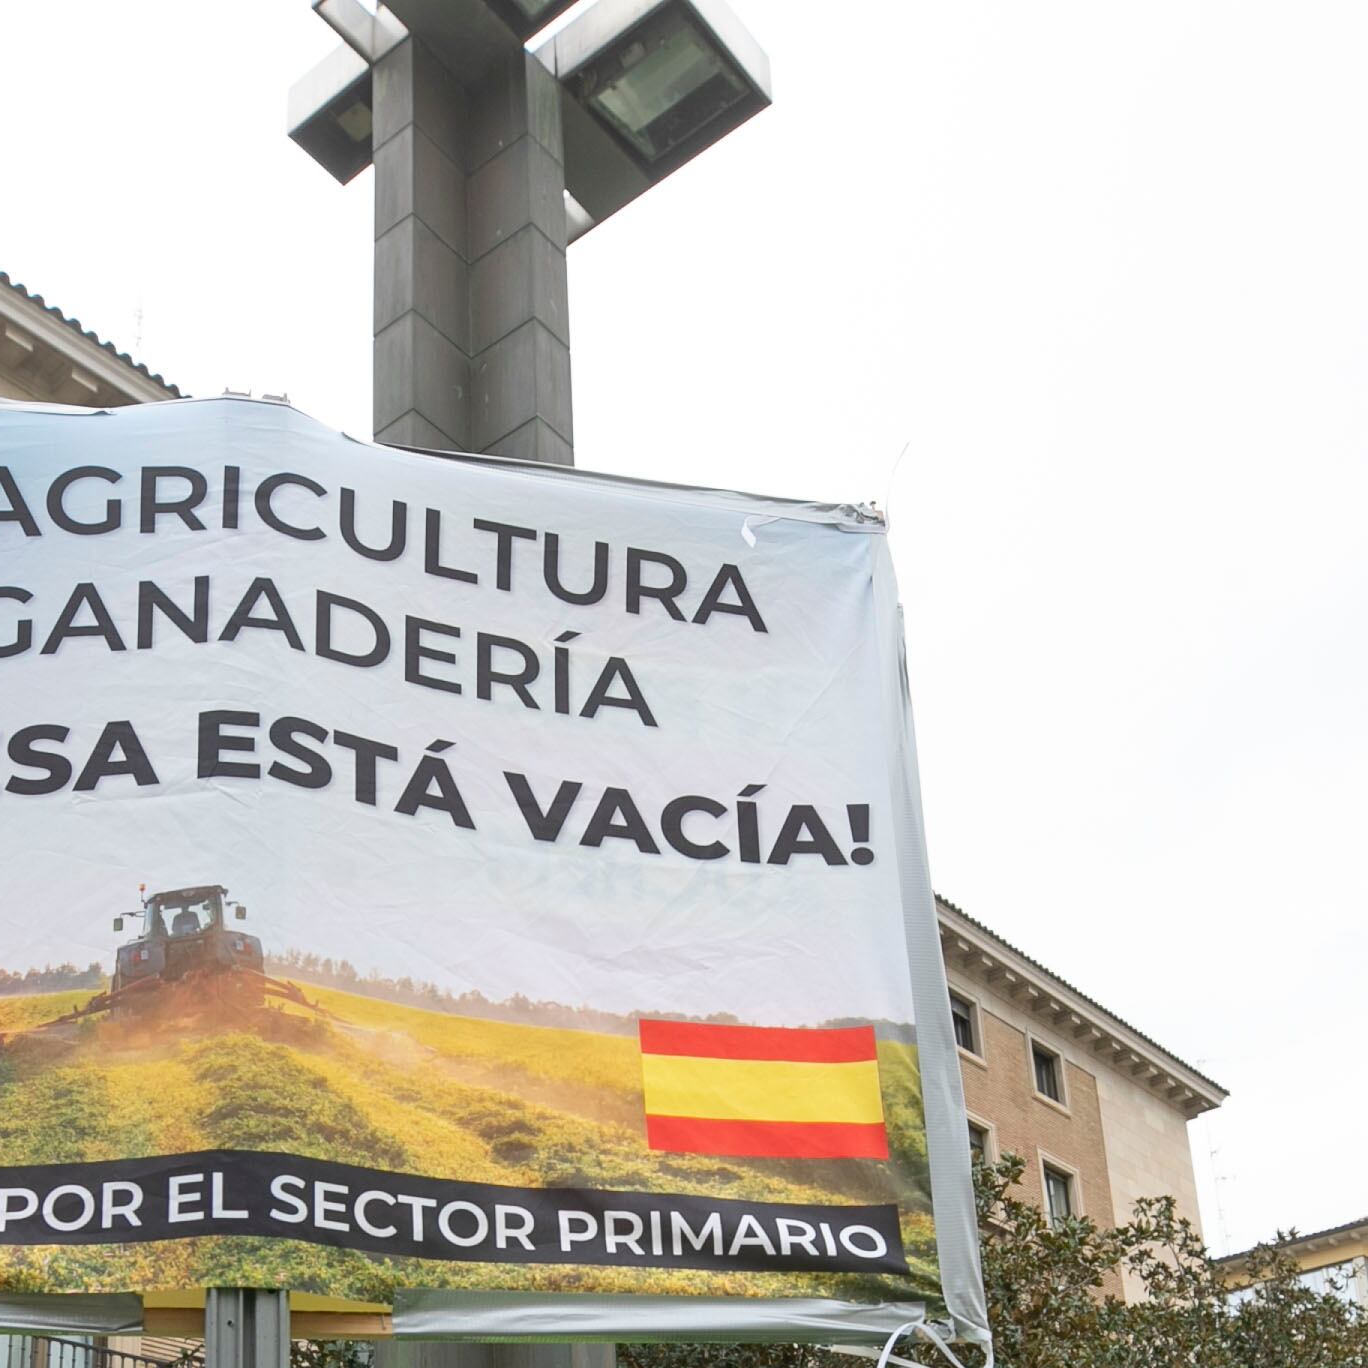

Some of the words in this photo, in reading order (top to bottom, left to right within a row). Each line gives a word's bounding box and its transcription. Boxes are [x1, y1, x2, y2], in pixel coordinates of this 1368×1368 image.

[197, 709, 477, 830] ESTÁ
[503, 771, 875, 867] VACÍA!
[168, 1170, 250, 1223] EL
[269, 1173, 537, 1252] SECTOR
[556, 1209, 889, 1259] PRIMARIO
